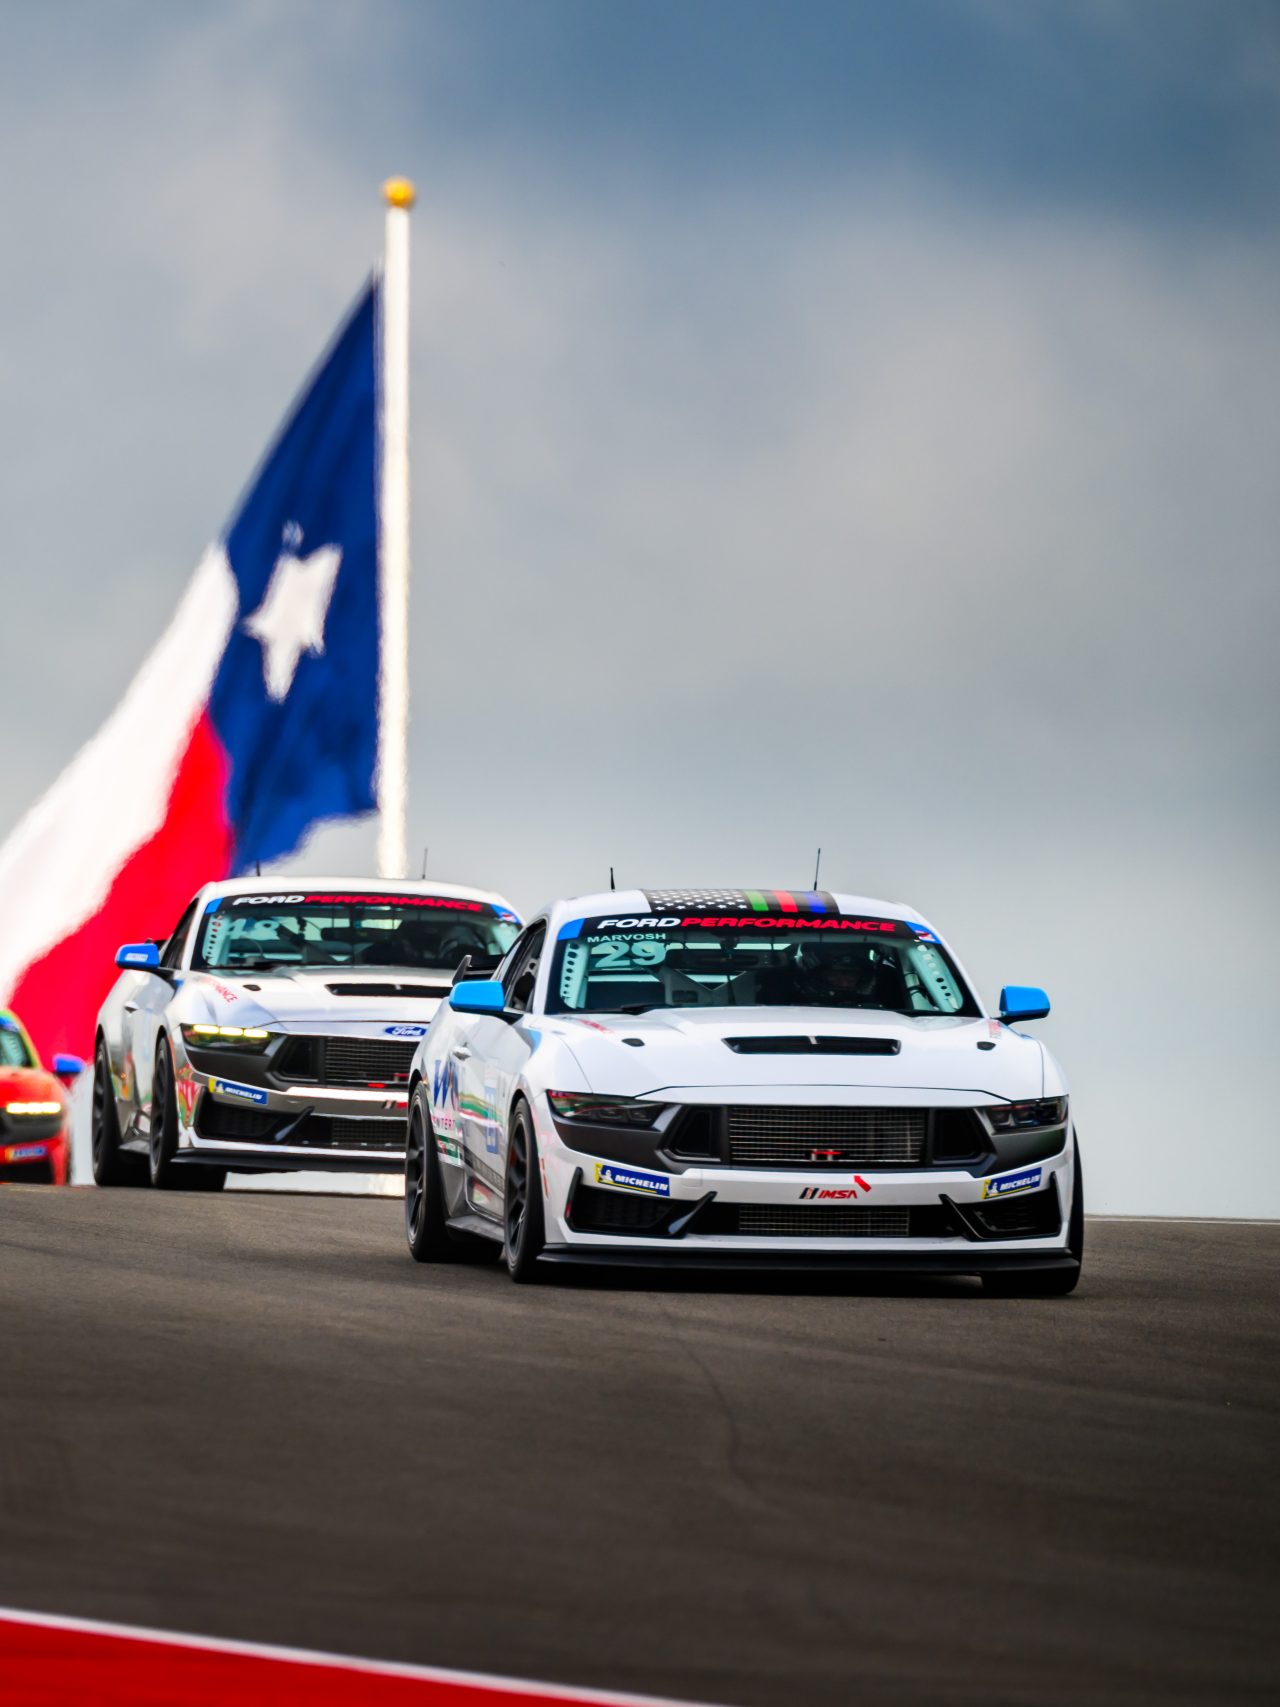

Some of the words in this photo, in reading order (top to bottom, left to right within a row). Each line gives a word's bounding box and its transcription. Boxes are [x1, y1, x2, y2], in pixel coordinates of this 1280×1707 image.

[597, 917, 681, 930] FORD
[681, 917, 897, 932] PERFORMANCE
[587, 932, 667, 943] MARVOSH
[592, 941, 667, 968] 29
[614, 1174, 669, 1191] MICHELIN
[999, 1174, 1041, 1191] MICHELIN
[818, 1189, 858, 1199] IMSA
